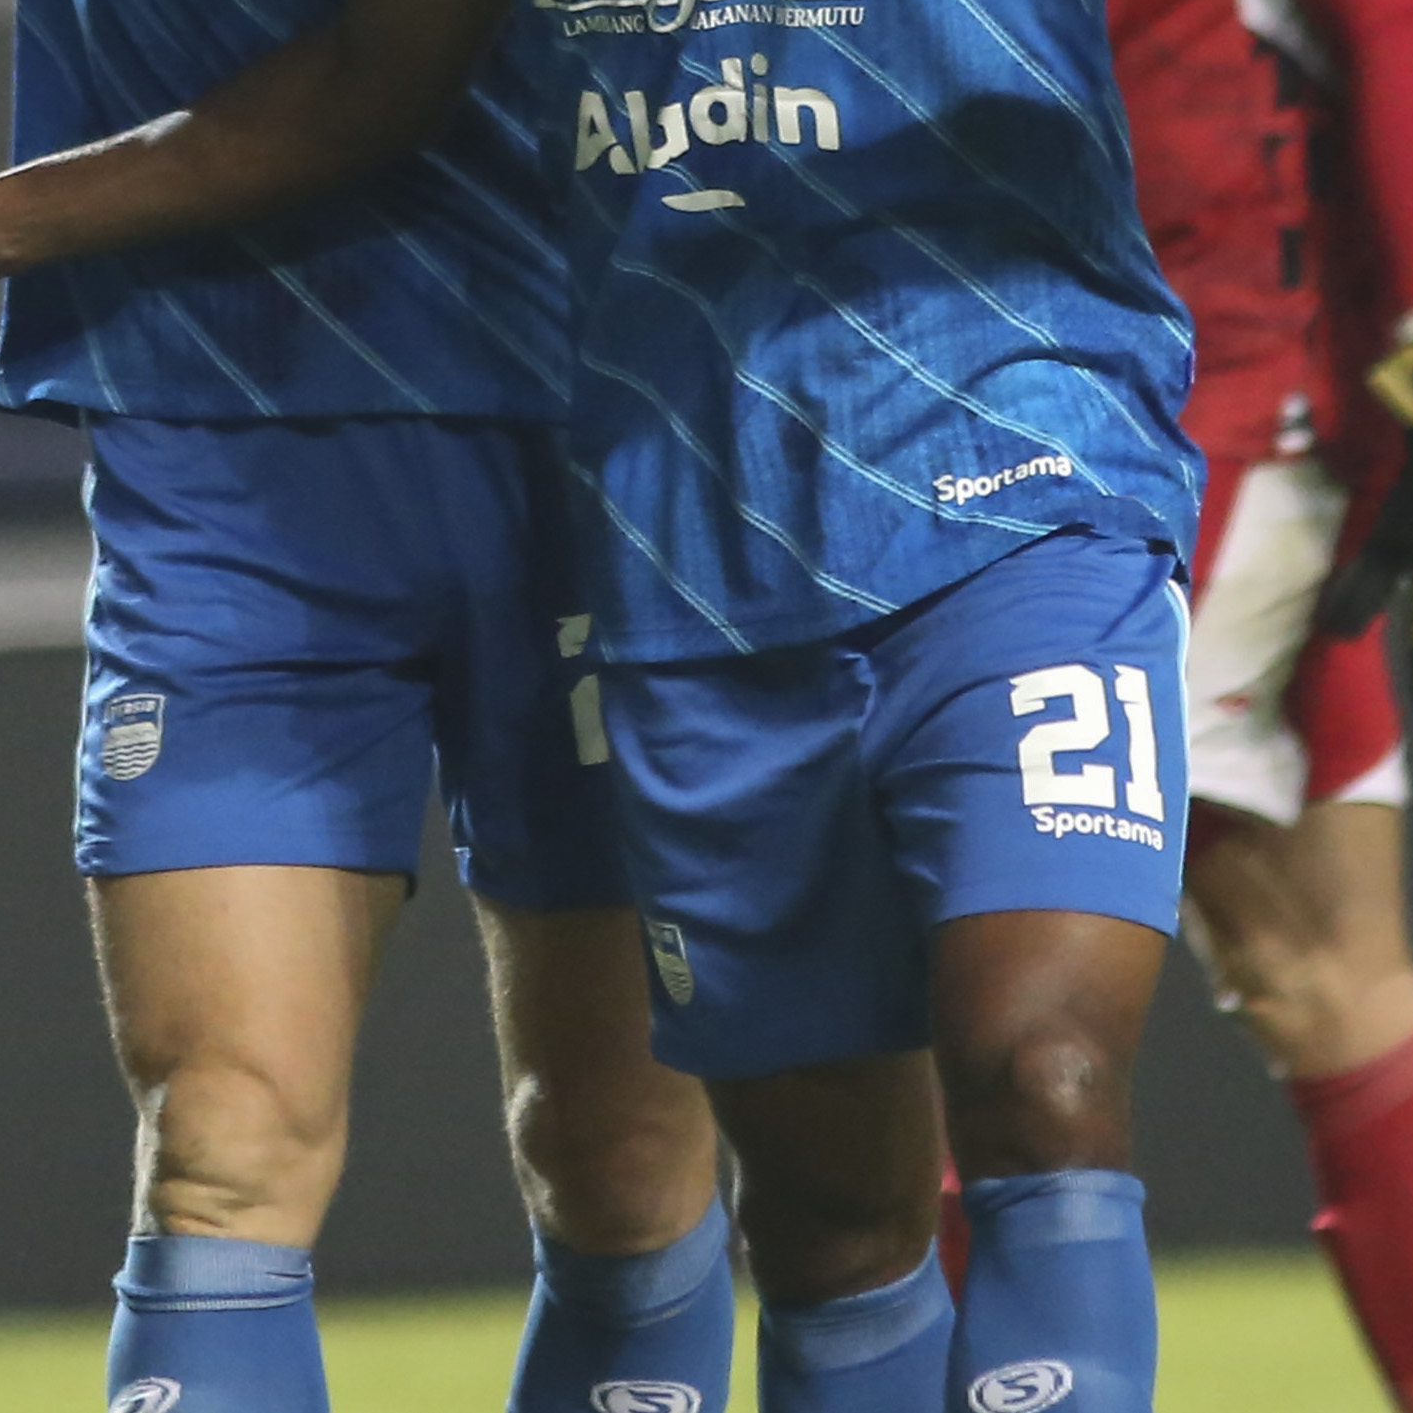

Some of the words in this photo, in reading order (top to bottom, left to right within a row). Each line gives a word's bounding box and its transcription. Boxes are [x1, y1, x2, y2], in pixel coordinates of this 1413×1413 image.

[932, 454, 1074, 506] Sportama
[1009, 663, 1165, 822] 21
[1031, 806, 1165, 851] Sportama
